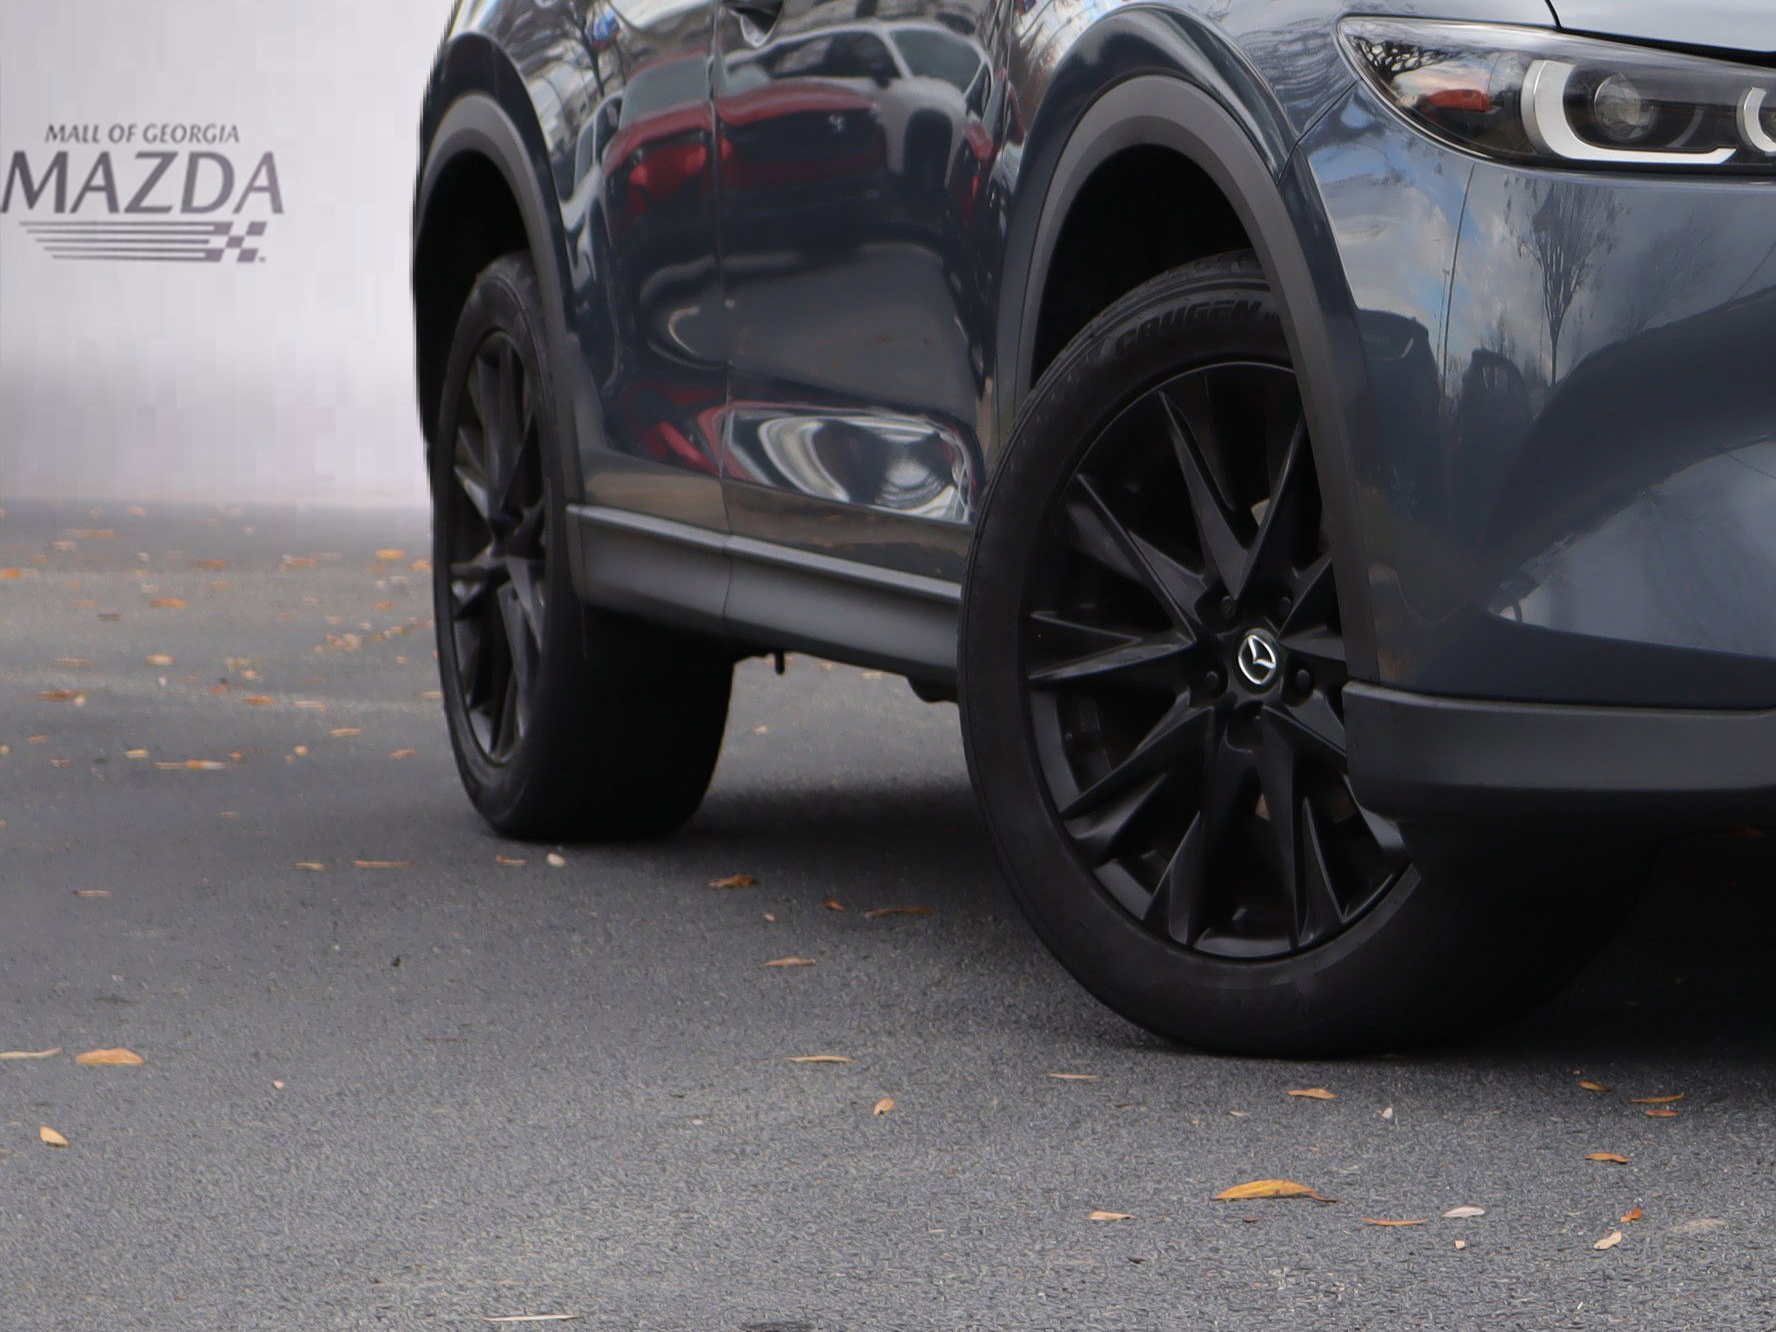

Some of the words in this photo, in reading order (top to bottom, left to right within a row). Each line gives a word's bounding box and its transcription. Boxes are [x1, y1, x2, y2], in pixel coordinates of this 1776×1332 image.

[44, 123, 100, 144] MALL
[107, 123, 137, 144] OF
[142, 123, 240, 145] GEORGIA
[0, 150, 284, 215] MAZDA
